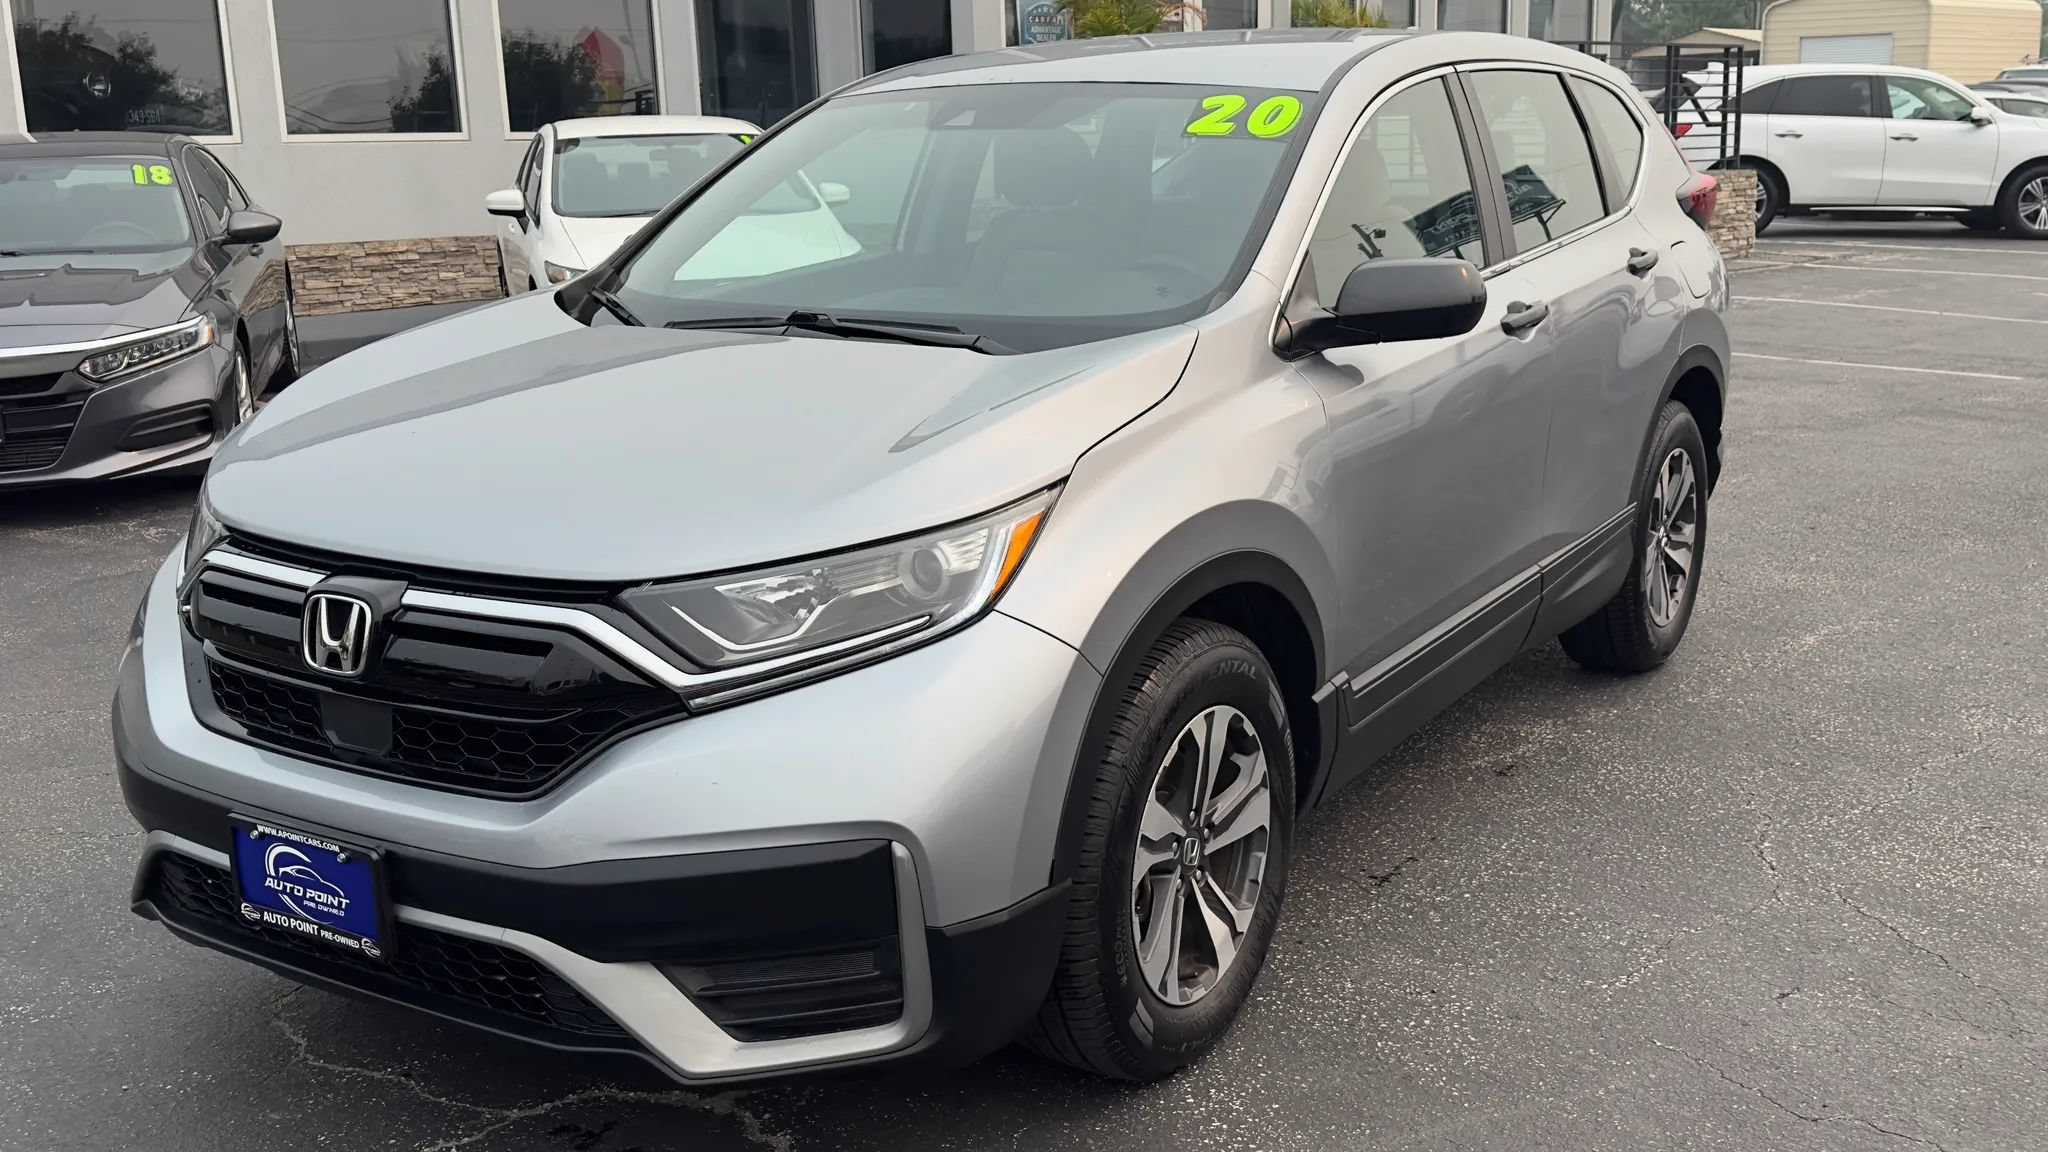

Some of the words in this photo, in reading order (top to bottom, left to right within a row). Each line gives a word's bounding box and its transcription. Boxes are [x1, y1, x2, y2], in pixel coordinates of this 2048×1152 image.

[1187, 95, 1303, 138] 20
[132, 164, 173, 185] 18
[256, 823, 340, 853] WWW.APOINTCARS.COM
[265, 877, 304, 897] AUTO
[305, 888, 350, 909] POINT
[303, 900, 317, 910] PRE
[317, 904, 345, 917] OWNED
[263, 911, 289, 927] AUTO
[290, 918, 319, 936] POINT
[320, 929, 360, 949] PRE-OWNED
